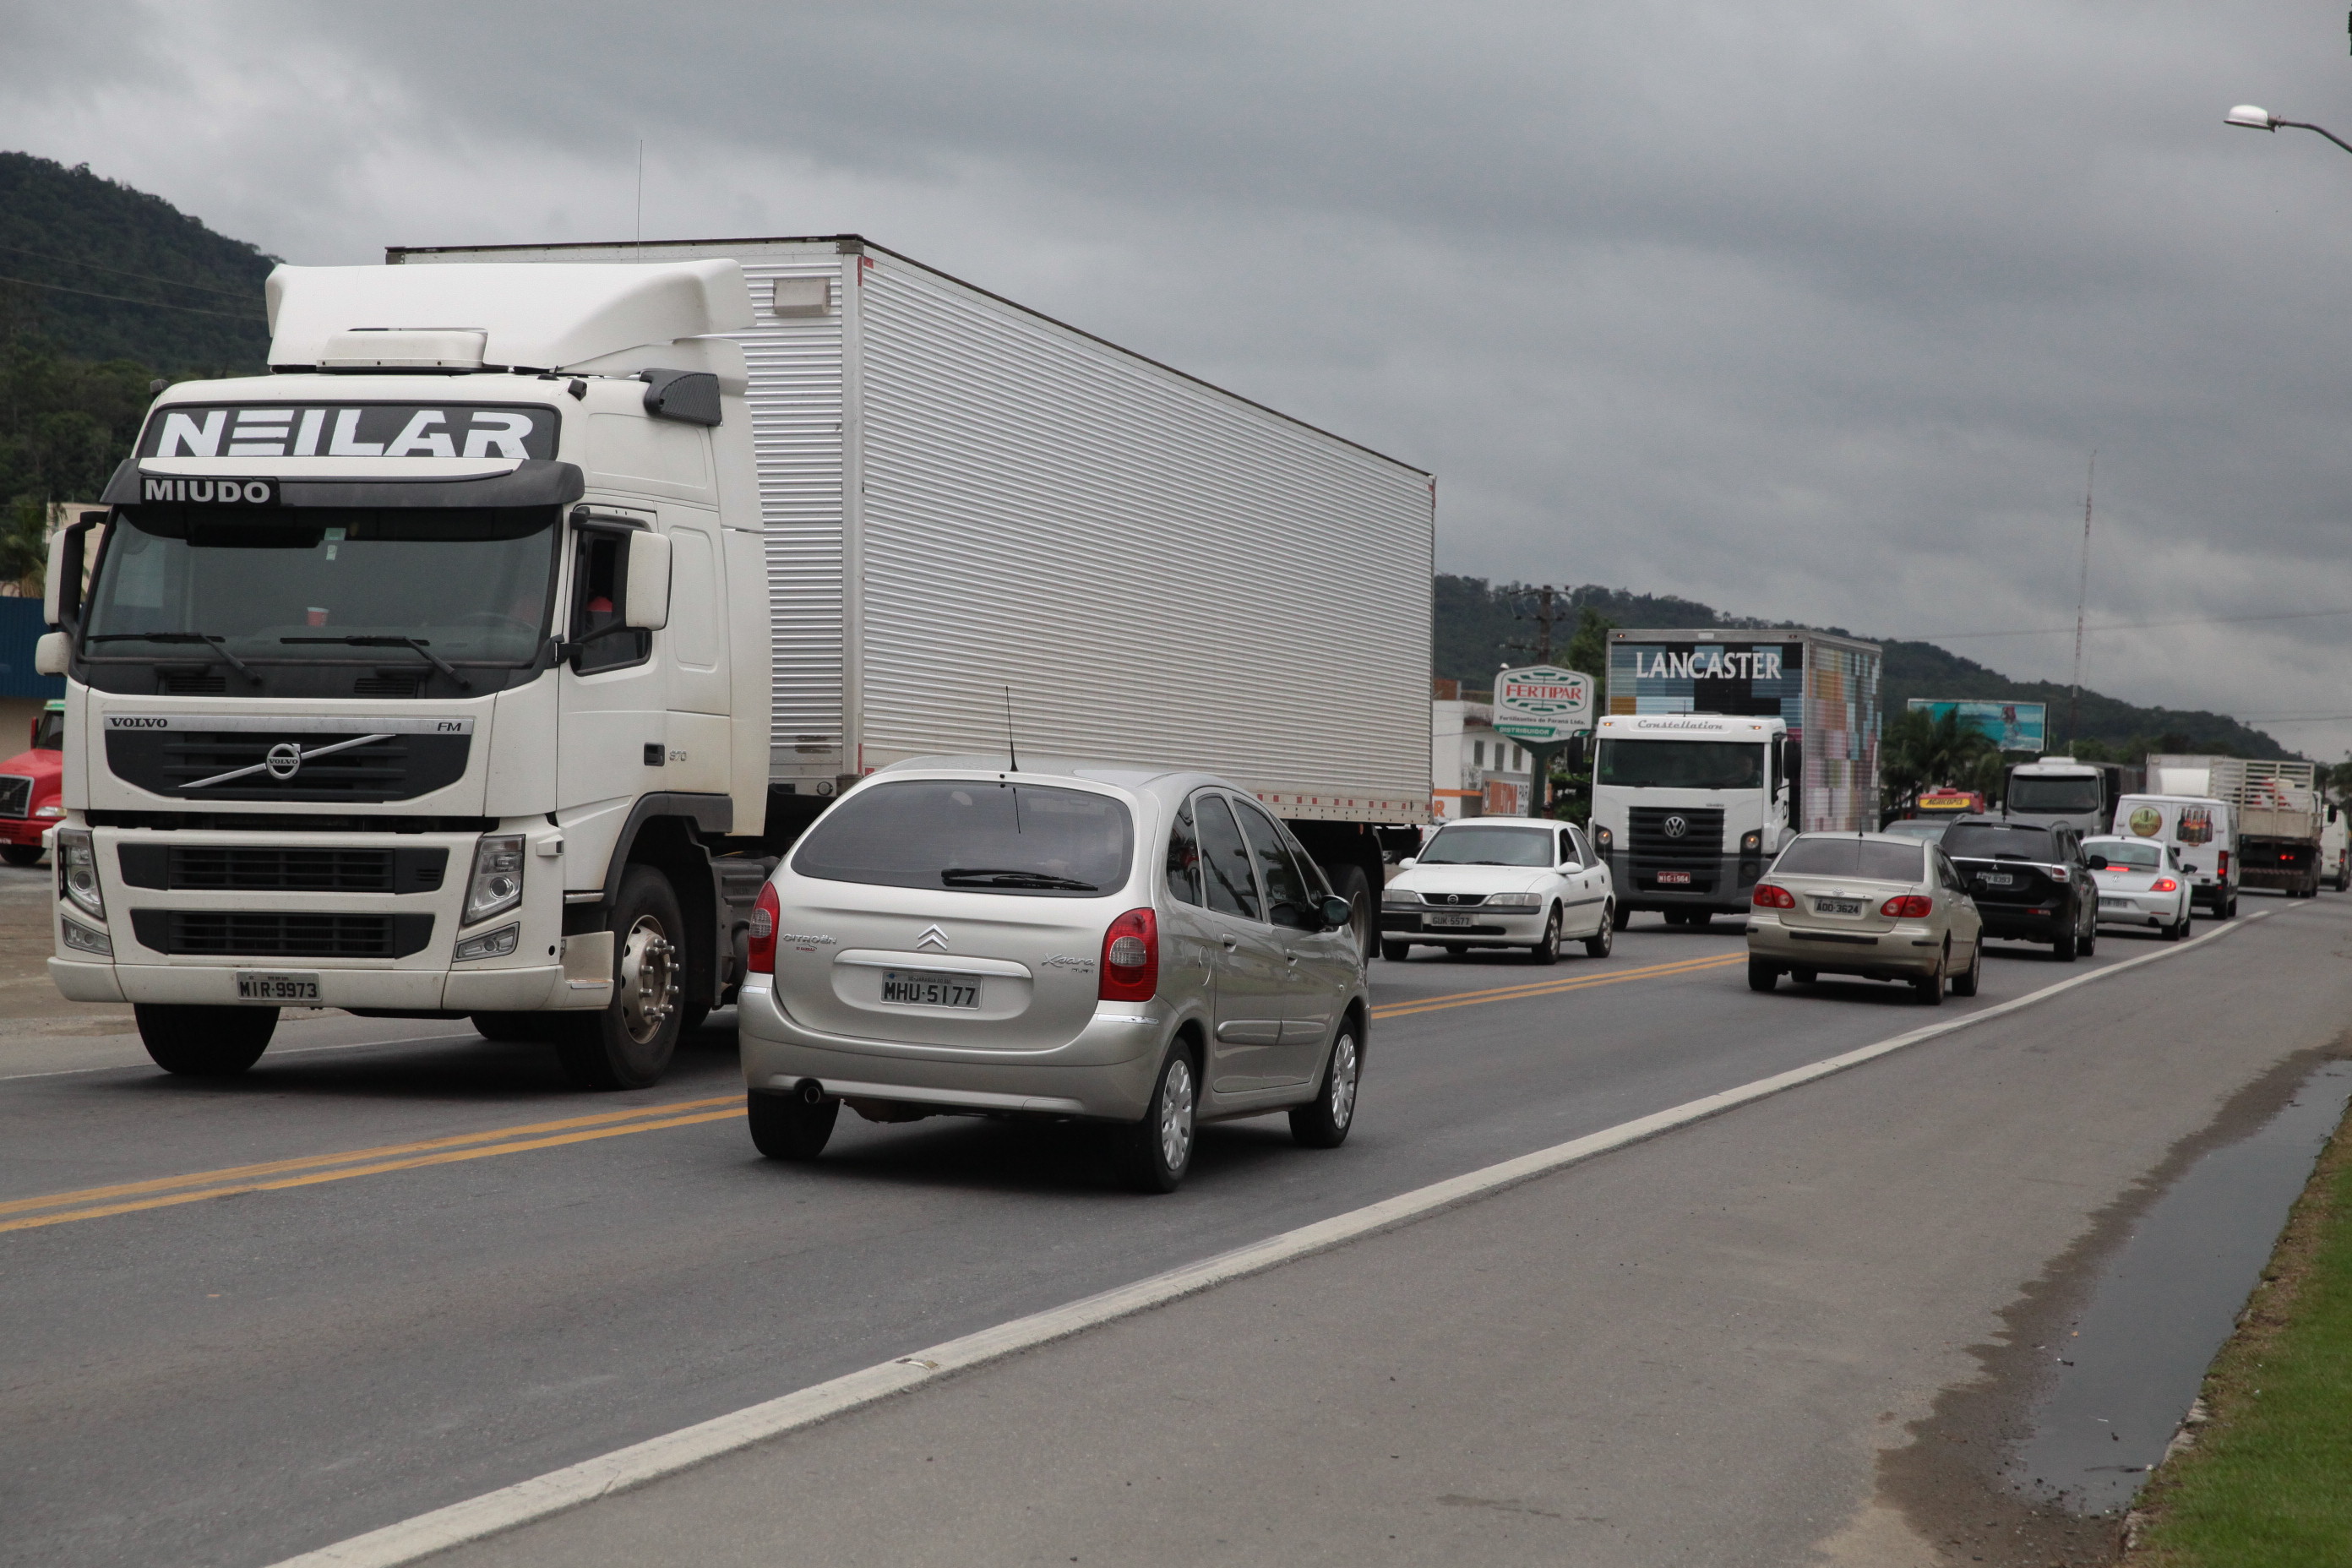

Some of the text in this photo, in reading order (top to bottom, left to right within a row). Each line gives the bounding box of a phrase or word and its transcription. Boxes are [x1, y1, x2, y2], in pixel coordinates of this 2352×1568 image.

[156, 409, 533, 460] NEILAR
[145, 479, 270, 504] MIUDO
[1636, 651, 1783, 679] LANCASTER
[1506, 684, 1582, 700] FERTIPAR
[110, 718, 168, 728] VOLVO
[438, 722, 461, 732] FM
[1637, 719, 1723, 731] Constellation
[783, 933, 837, 945] CITROËN
[1041, 952, 1095, 968] Xsara
